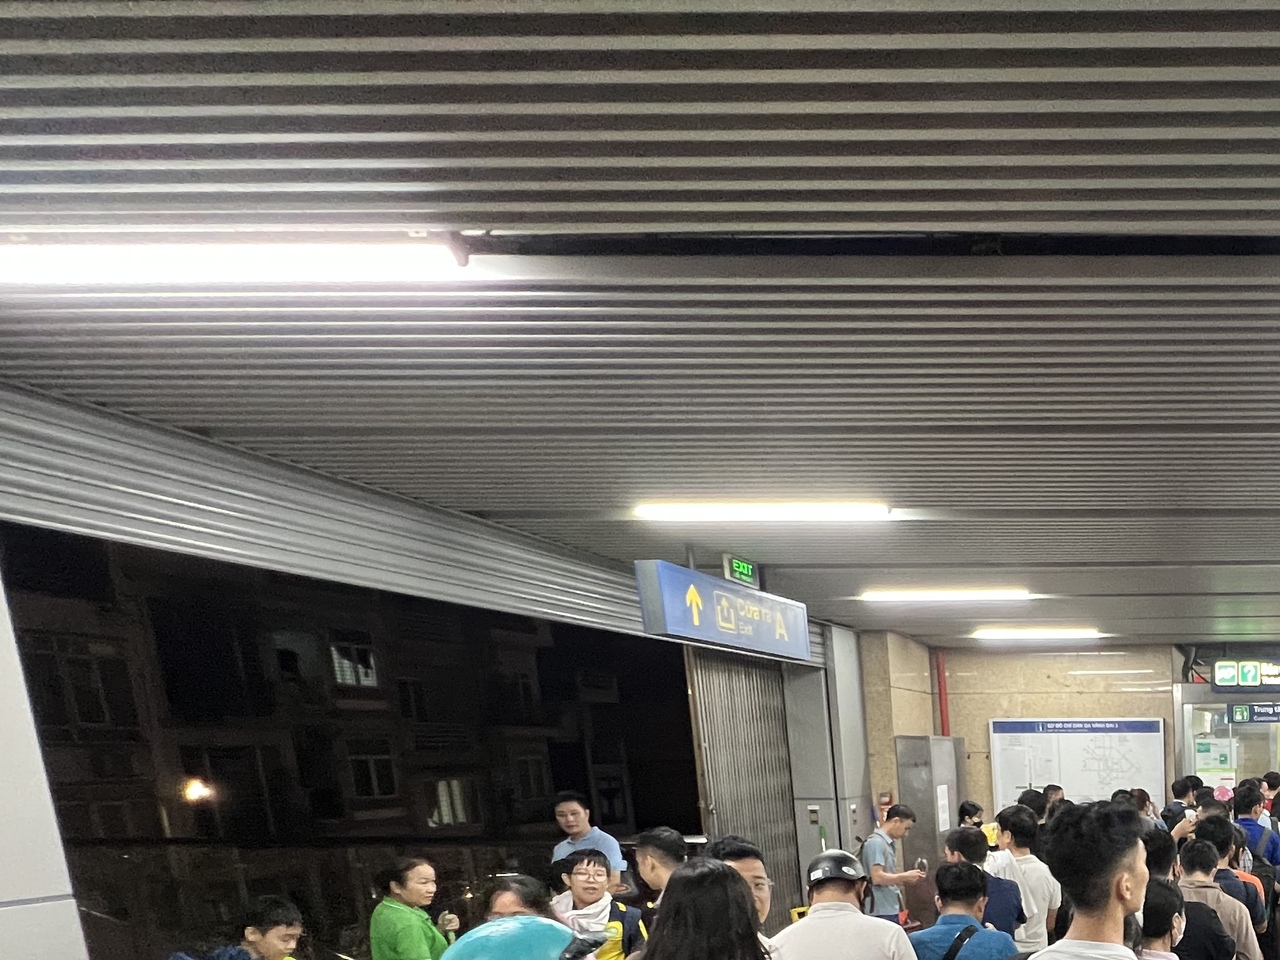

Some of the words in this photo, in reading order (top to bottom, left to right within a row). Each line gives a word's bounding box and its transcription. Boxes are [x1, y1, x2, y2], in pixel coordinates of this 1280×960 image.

[732, 559, 753, 575] EXIT
[738, 621, 753, 636] Exit
[775, 612, 789, 642] A
[1253, 706, 1274, 715] Trung
